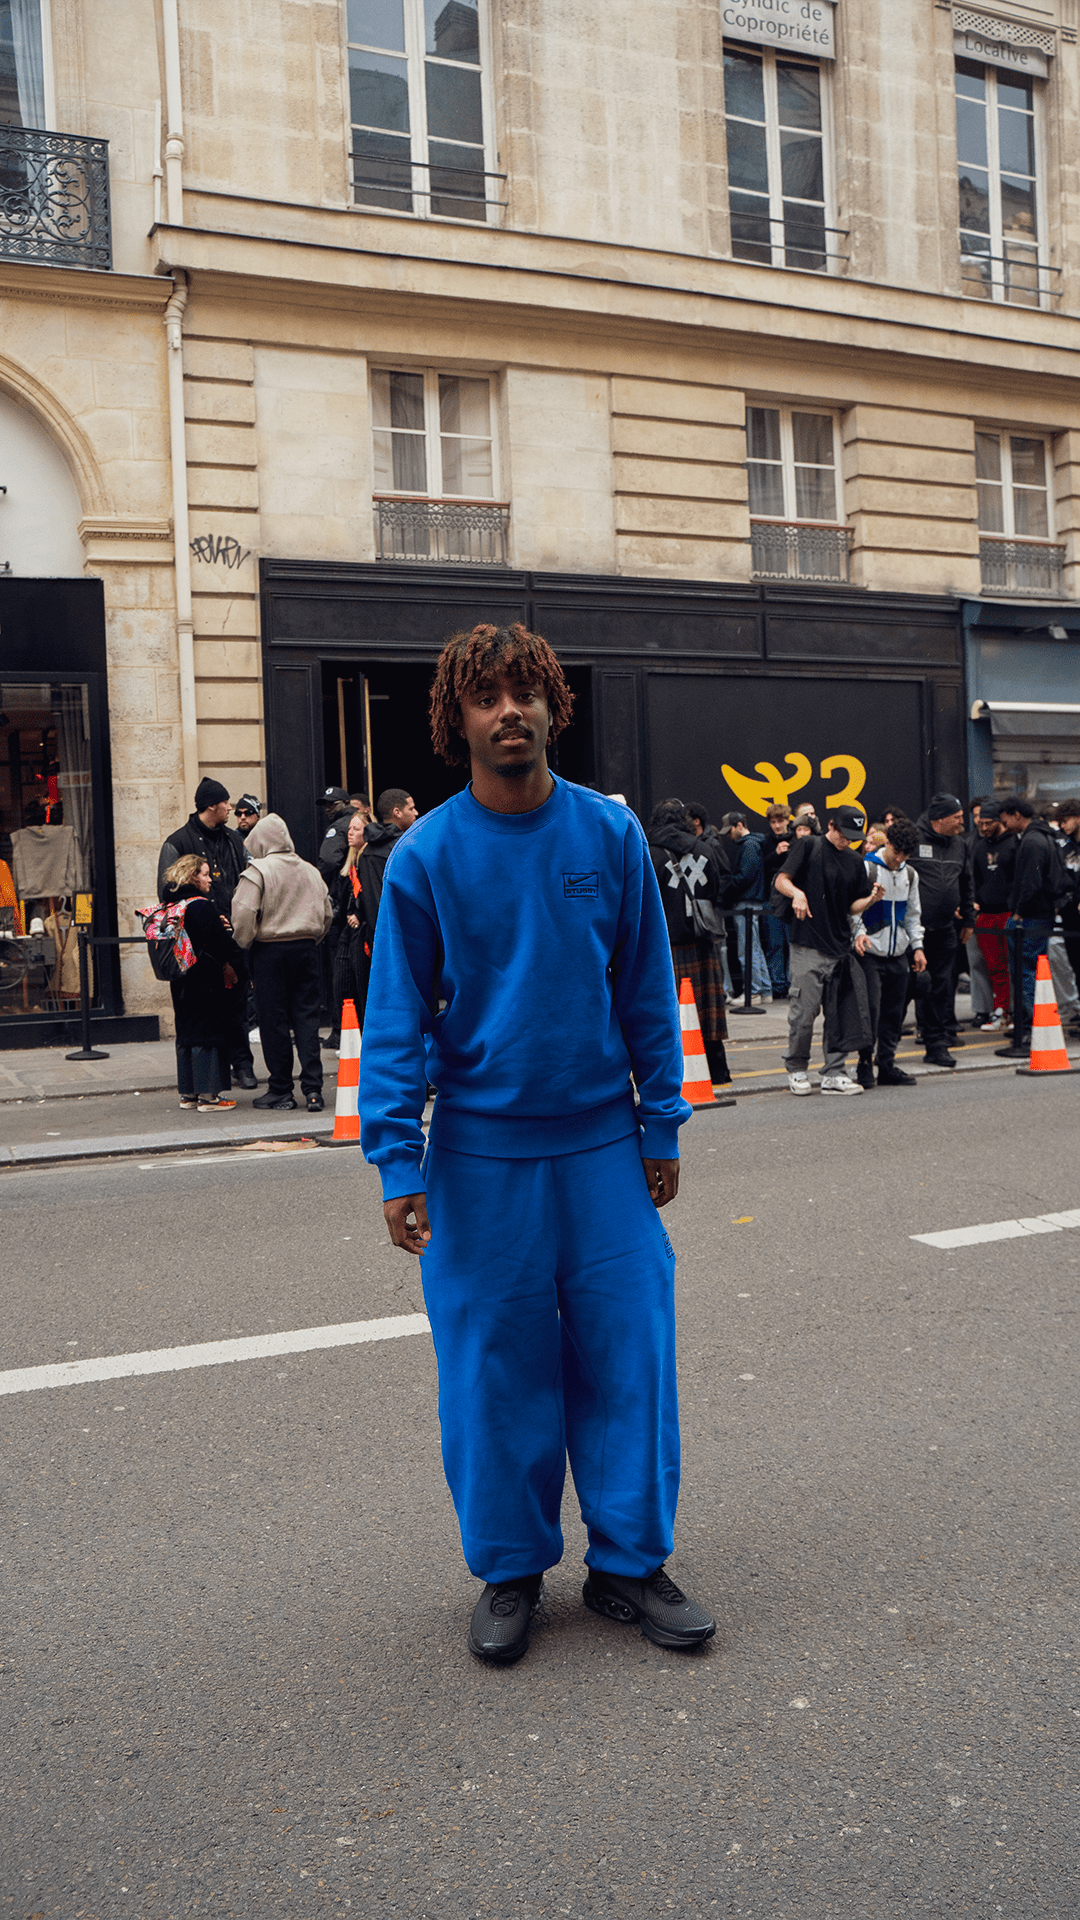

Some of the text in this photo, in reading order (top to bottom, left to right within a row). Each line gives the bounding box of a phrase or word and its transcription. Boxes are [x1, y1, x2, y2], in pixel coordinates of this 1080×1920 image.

[731, 0, 822, 21] yndic de
[723, 9, 829, 45] Copropriété
[964, 34, 1028, 65] Locative
